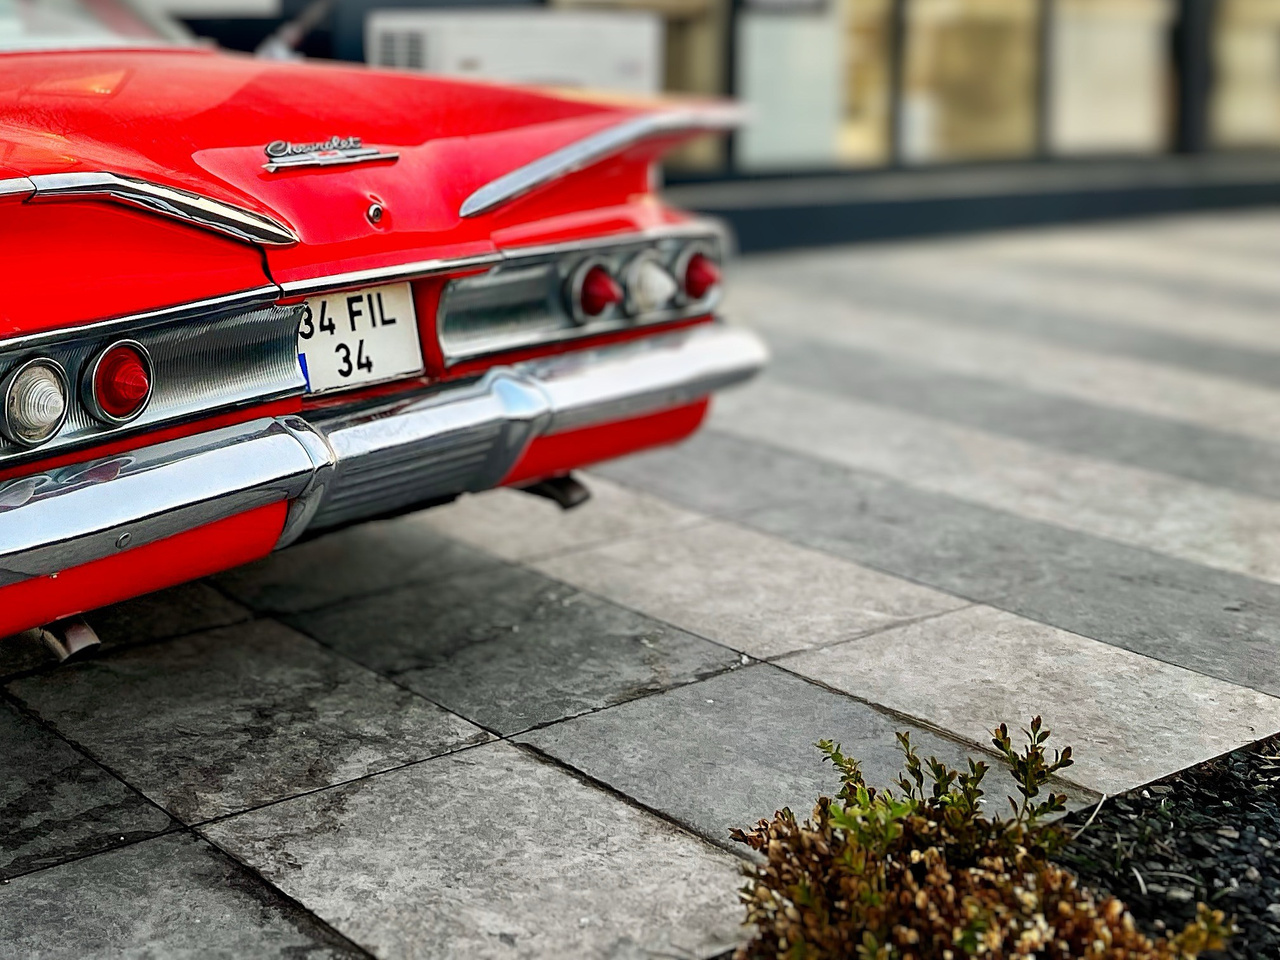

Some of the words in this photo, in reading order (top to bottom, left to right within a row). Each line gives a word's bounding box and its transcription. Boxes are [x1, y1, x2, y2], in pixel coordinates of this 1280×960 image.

[264, 135, 362, 158] Chevrolet
[298, 301, 336, 339] 34
[346, 292, 397, 332] FIL
[335, 339, 373, 378] 34
